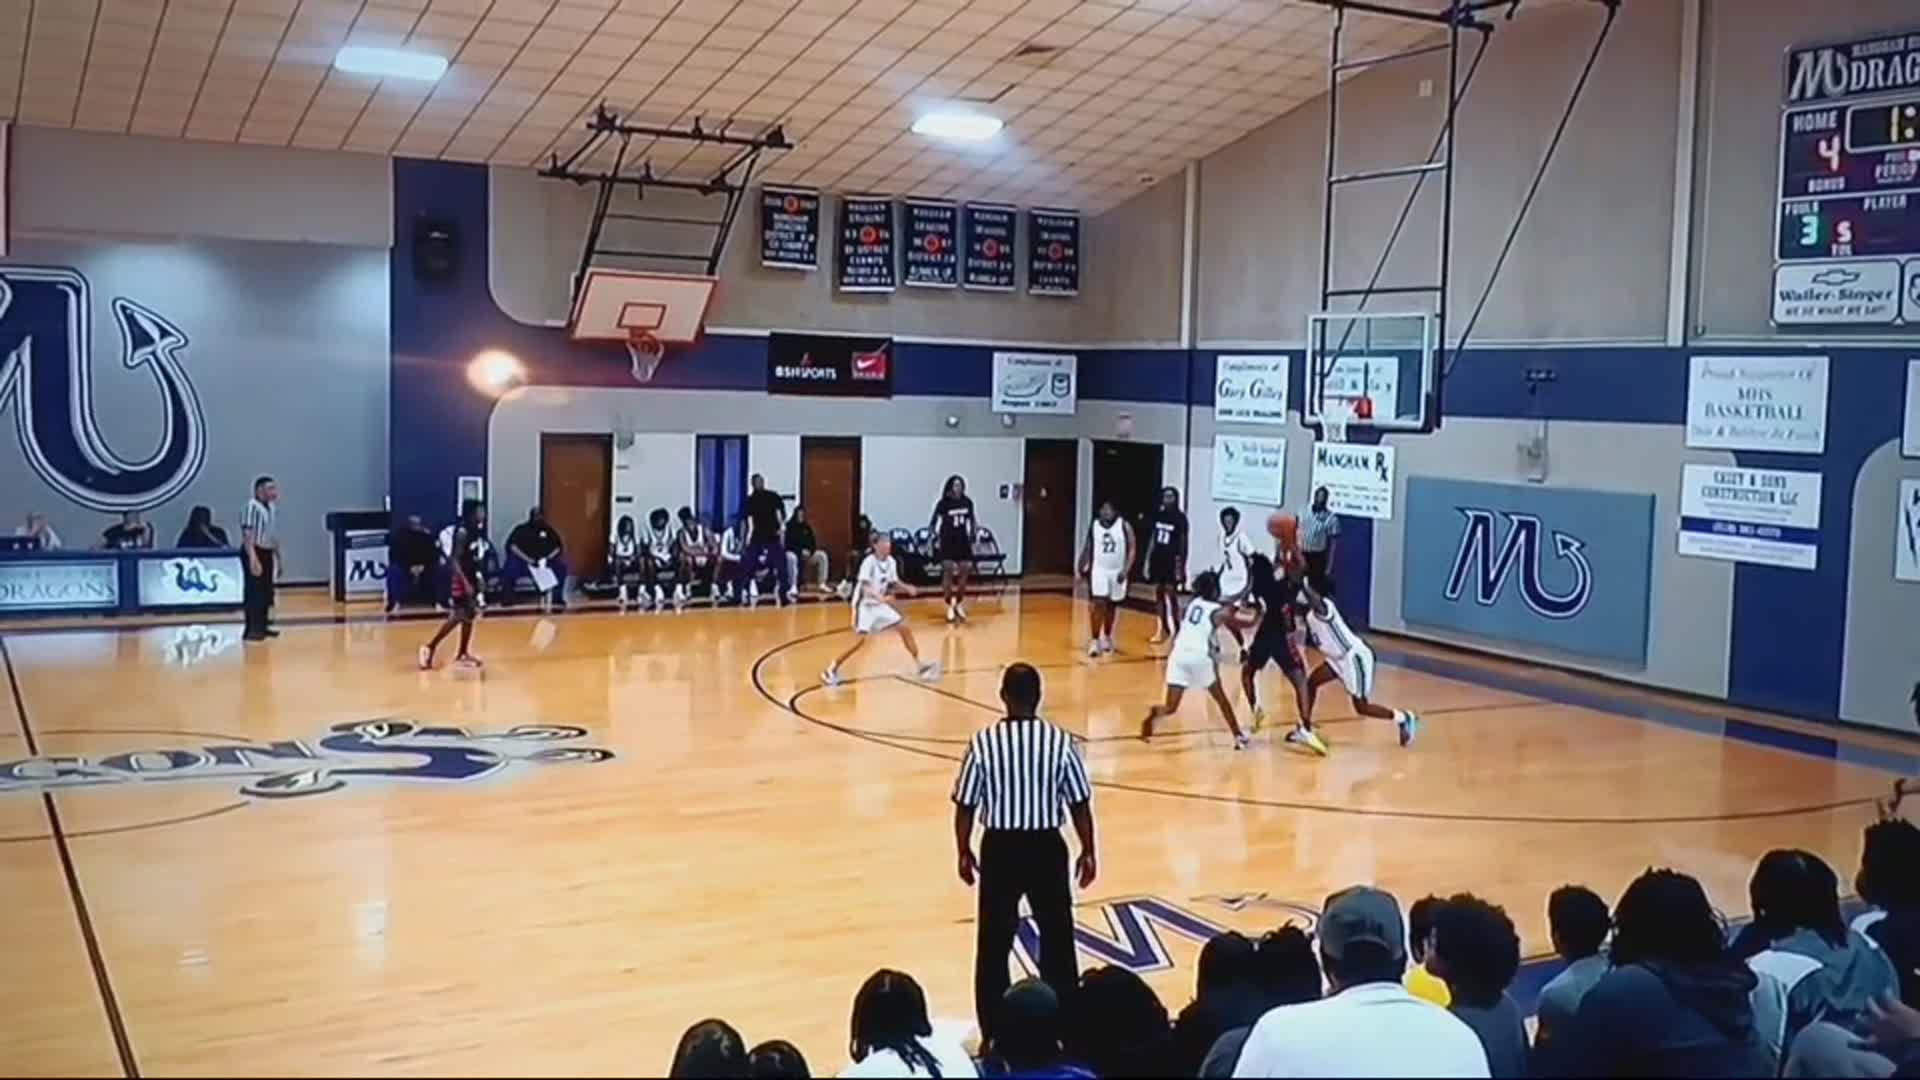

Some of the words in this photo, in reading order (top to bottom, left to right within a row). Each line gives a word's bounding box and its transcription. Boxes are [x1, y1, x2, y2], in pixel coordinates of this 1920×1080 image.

[1792, 110, 1838, 132] HOME
[1818, 134, 1840, 173] 4
[1800, 215, 1819, 246] 3
